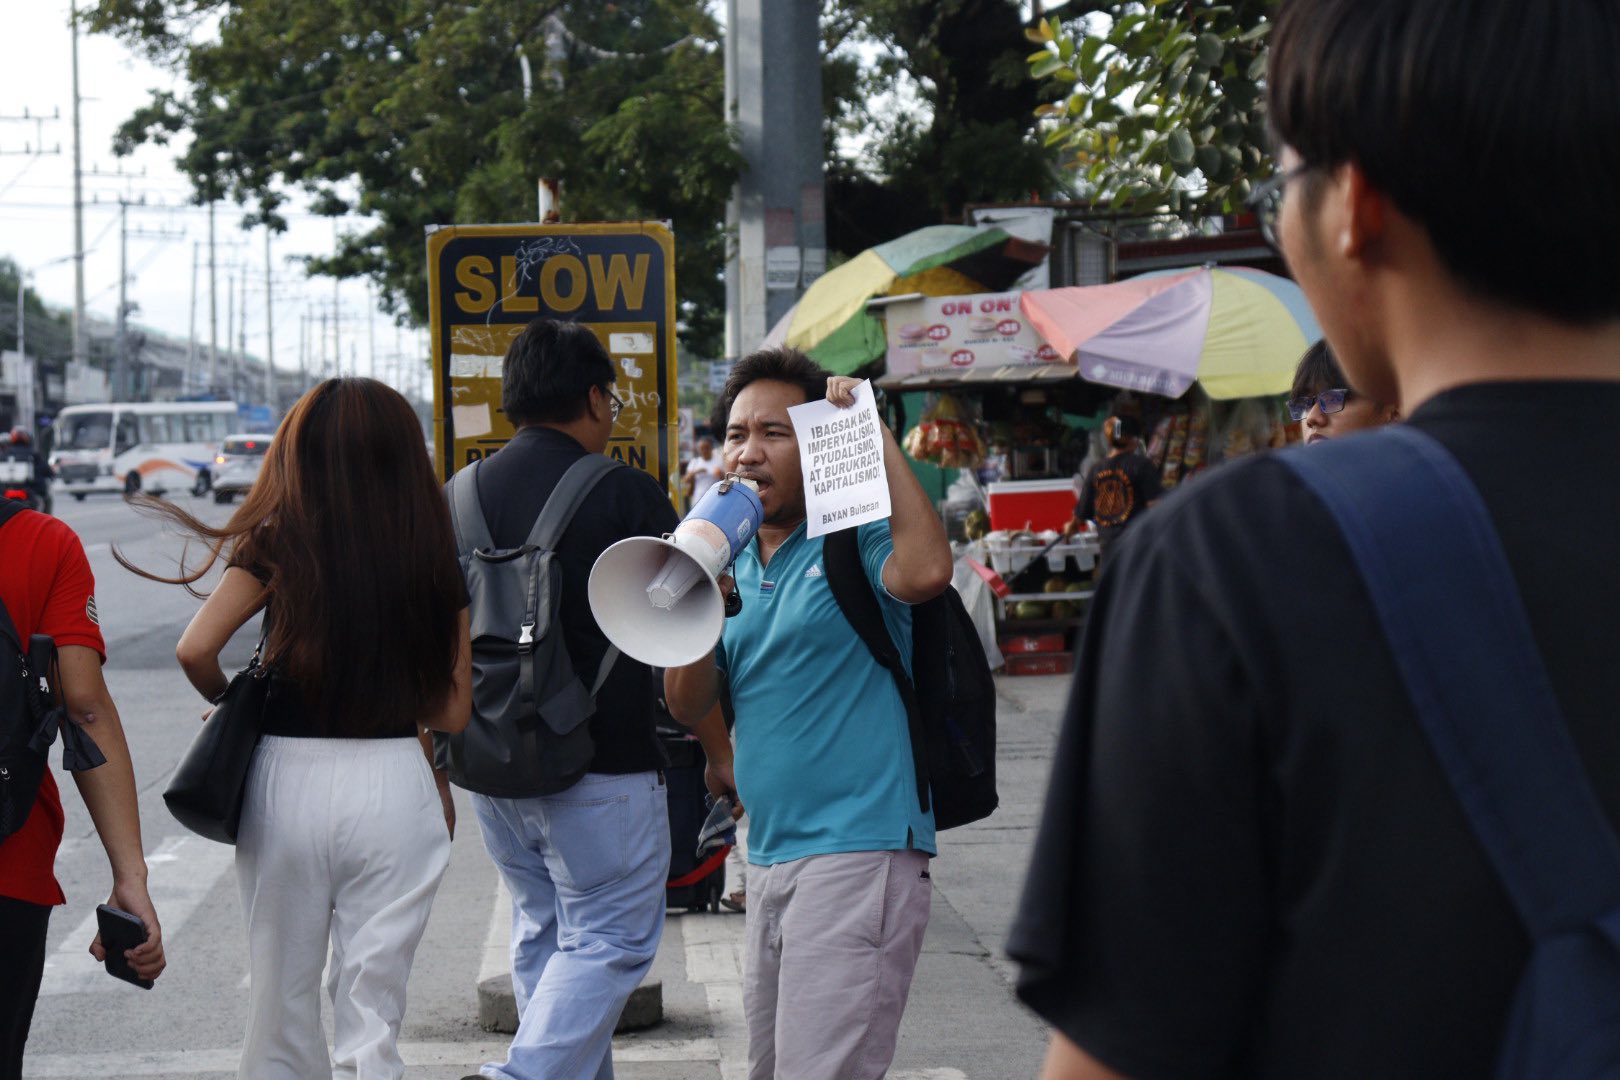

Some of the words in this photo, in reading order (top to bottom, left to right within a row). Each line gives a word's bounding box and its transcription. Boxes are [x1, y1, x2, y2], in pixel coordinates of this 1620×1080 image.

[454, 253, 650, 313] SLOW
[941, 302, 972, 316] ON
[811, 415, 857, 440] IBAGSAK
[858, 408, 872, 425] ANG
[809, 468, 822, 484] AT
[824, 449, 881, 479] BURUKRATA
[814, 465, 881, 496] KAPITALISMO!
[822, 508, 848, 525] BAYAN
[850, 501, 880, 517] Bulacan
